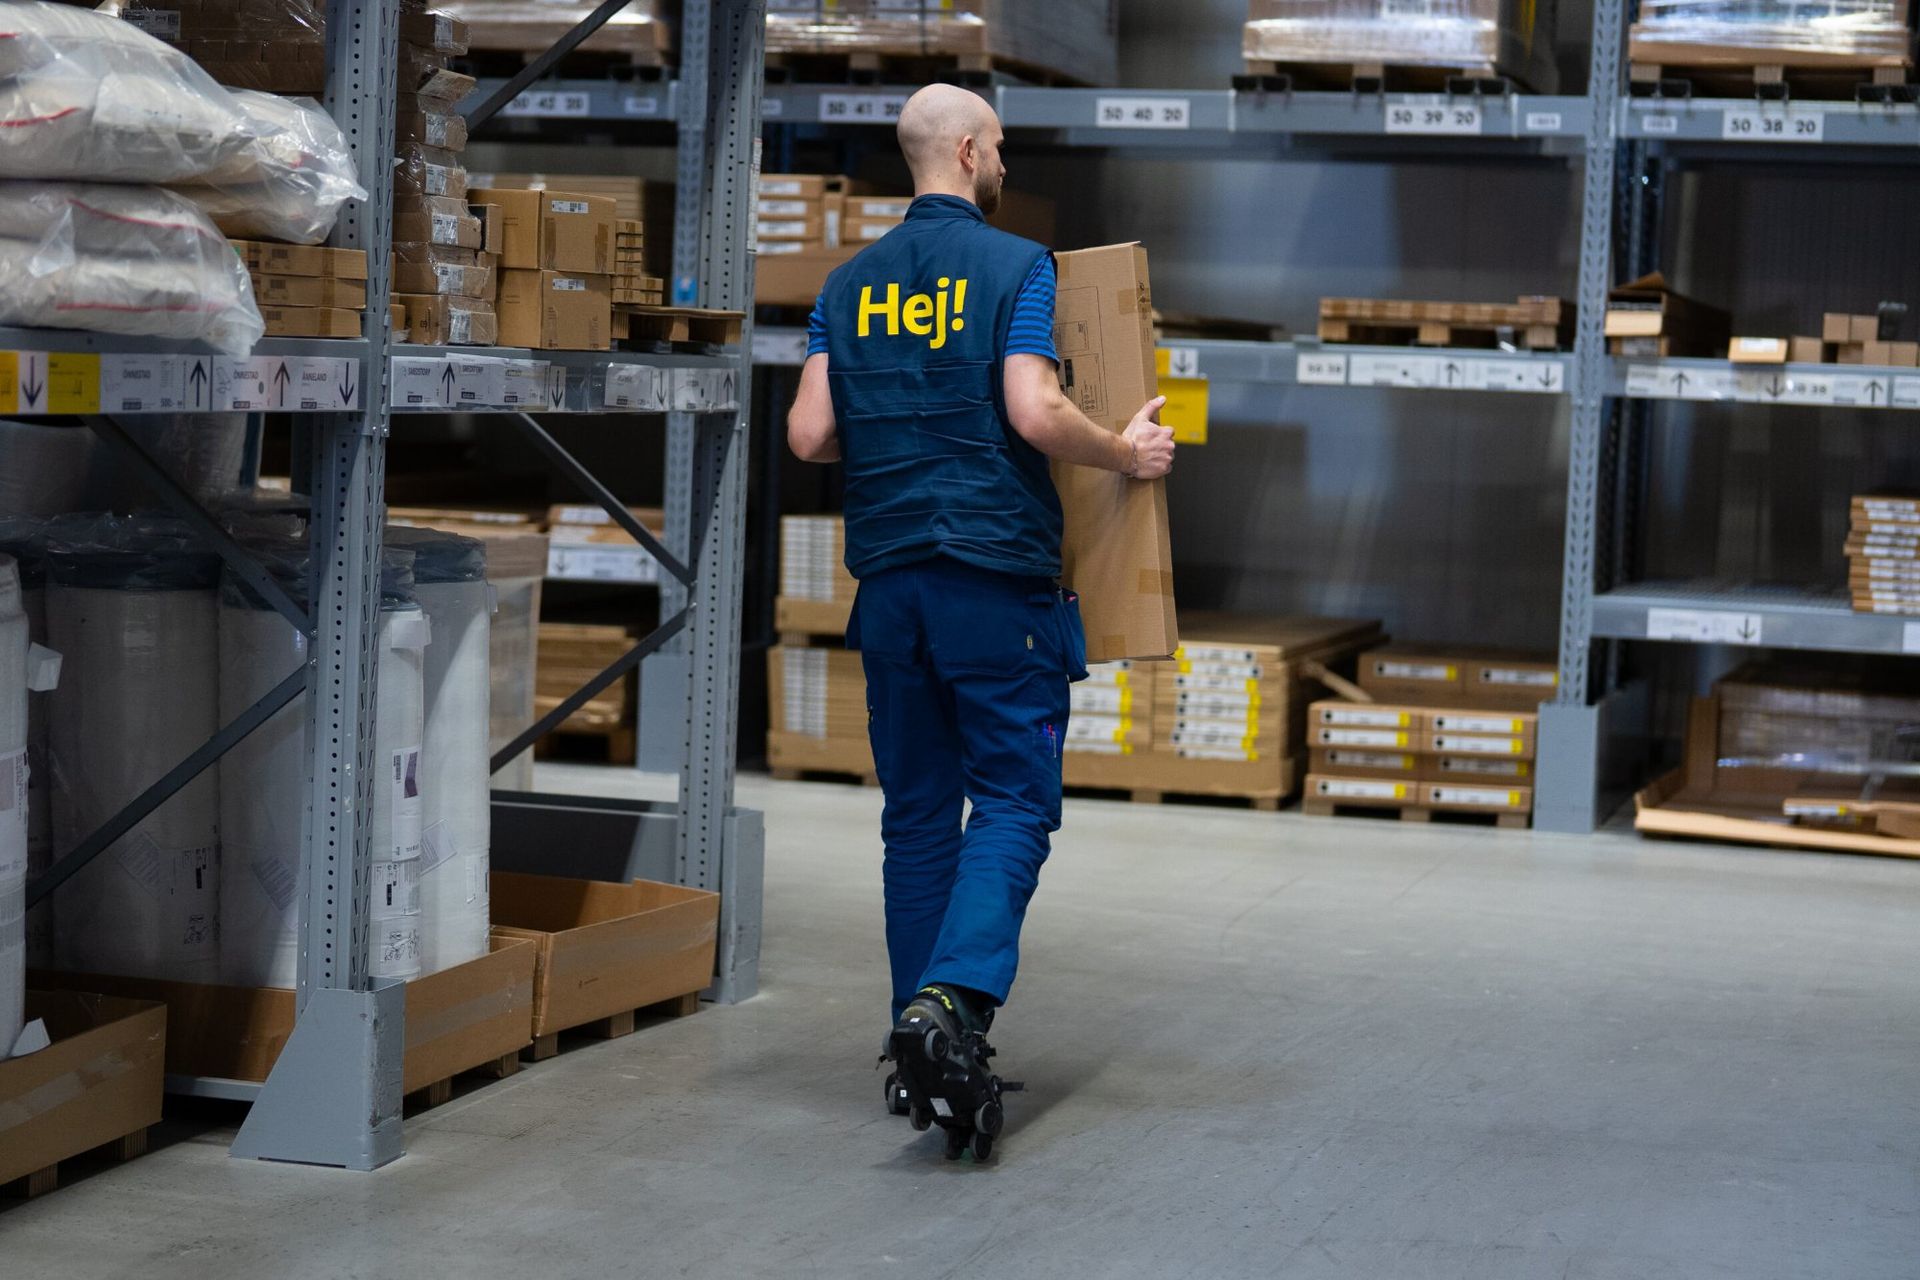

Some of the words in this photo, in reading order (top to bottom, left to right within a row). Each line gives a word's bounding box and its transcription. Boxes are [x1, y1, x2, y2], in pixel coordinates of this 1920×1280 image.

[827, 100, 847, 115] 50
[854, 101, 873, 115] 41
[1103, 106, 1124, 121] 50
[1134, 107, 1153, 121] 40
[1163, 107, 1183, 122] 20
[1392, 109, 1413, 124] 50
[1424, 109, 1443, 124] 39
[1455, 110, 1474, 126] 20
[1730, 118, 1752, 133] 50
[1762, 119, 1783, 134] 38
[1796, 120, 1816, 135] 20
[858, 277, 967, 349] Hej!
